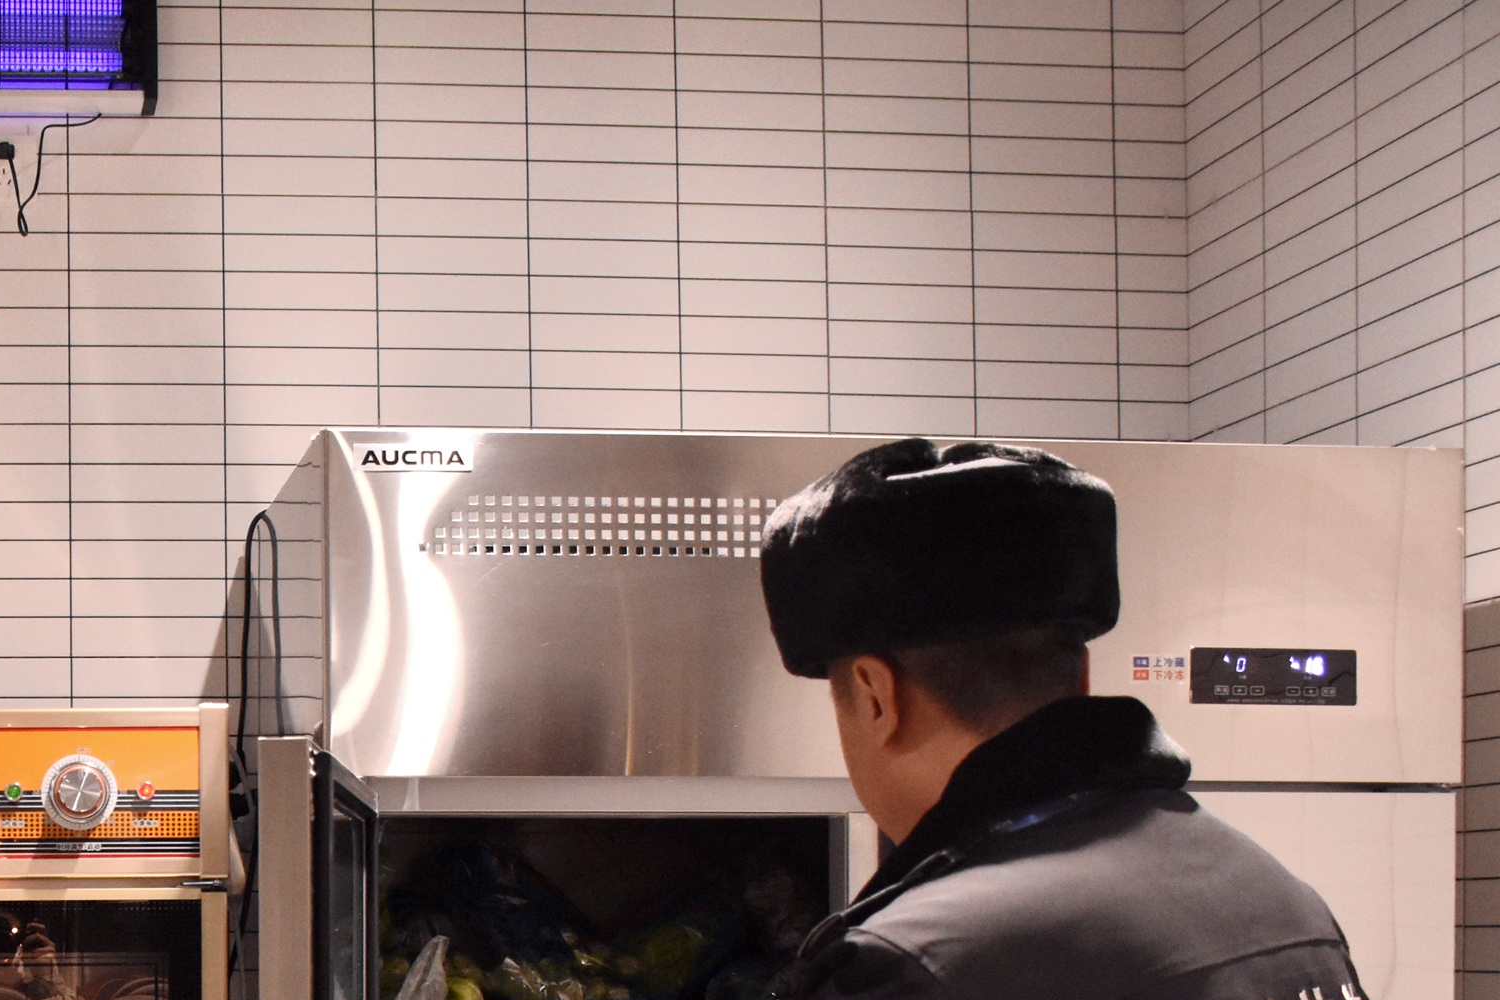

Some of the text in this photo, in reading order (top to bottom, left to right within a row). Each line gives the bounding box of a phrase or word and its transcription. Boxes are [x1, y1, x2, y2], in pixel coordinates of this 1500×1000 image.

[361, 450, 465, 466] AUCMA
[1153, 670, 1185, 681] 下冷冻
